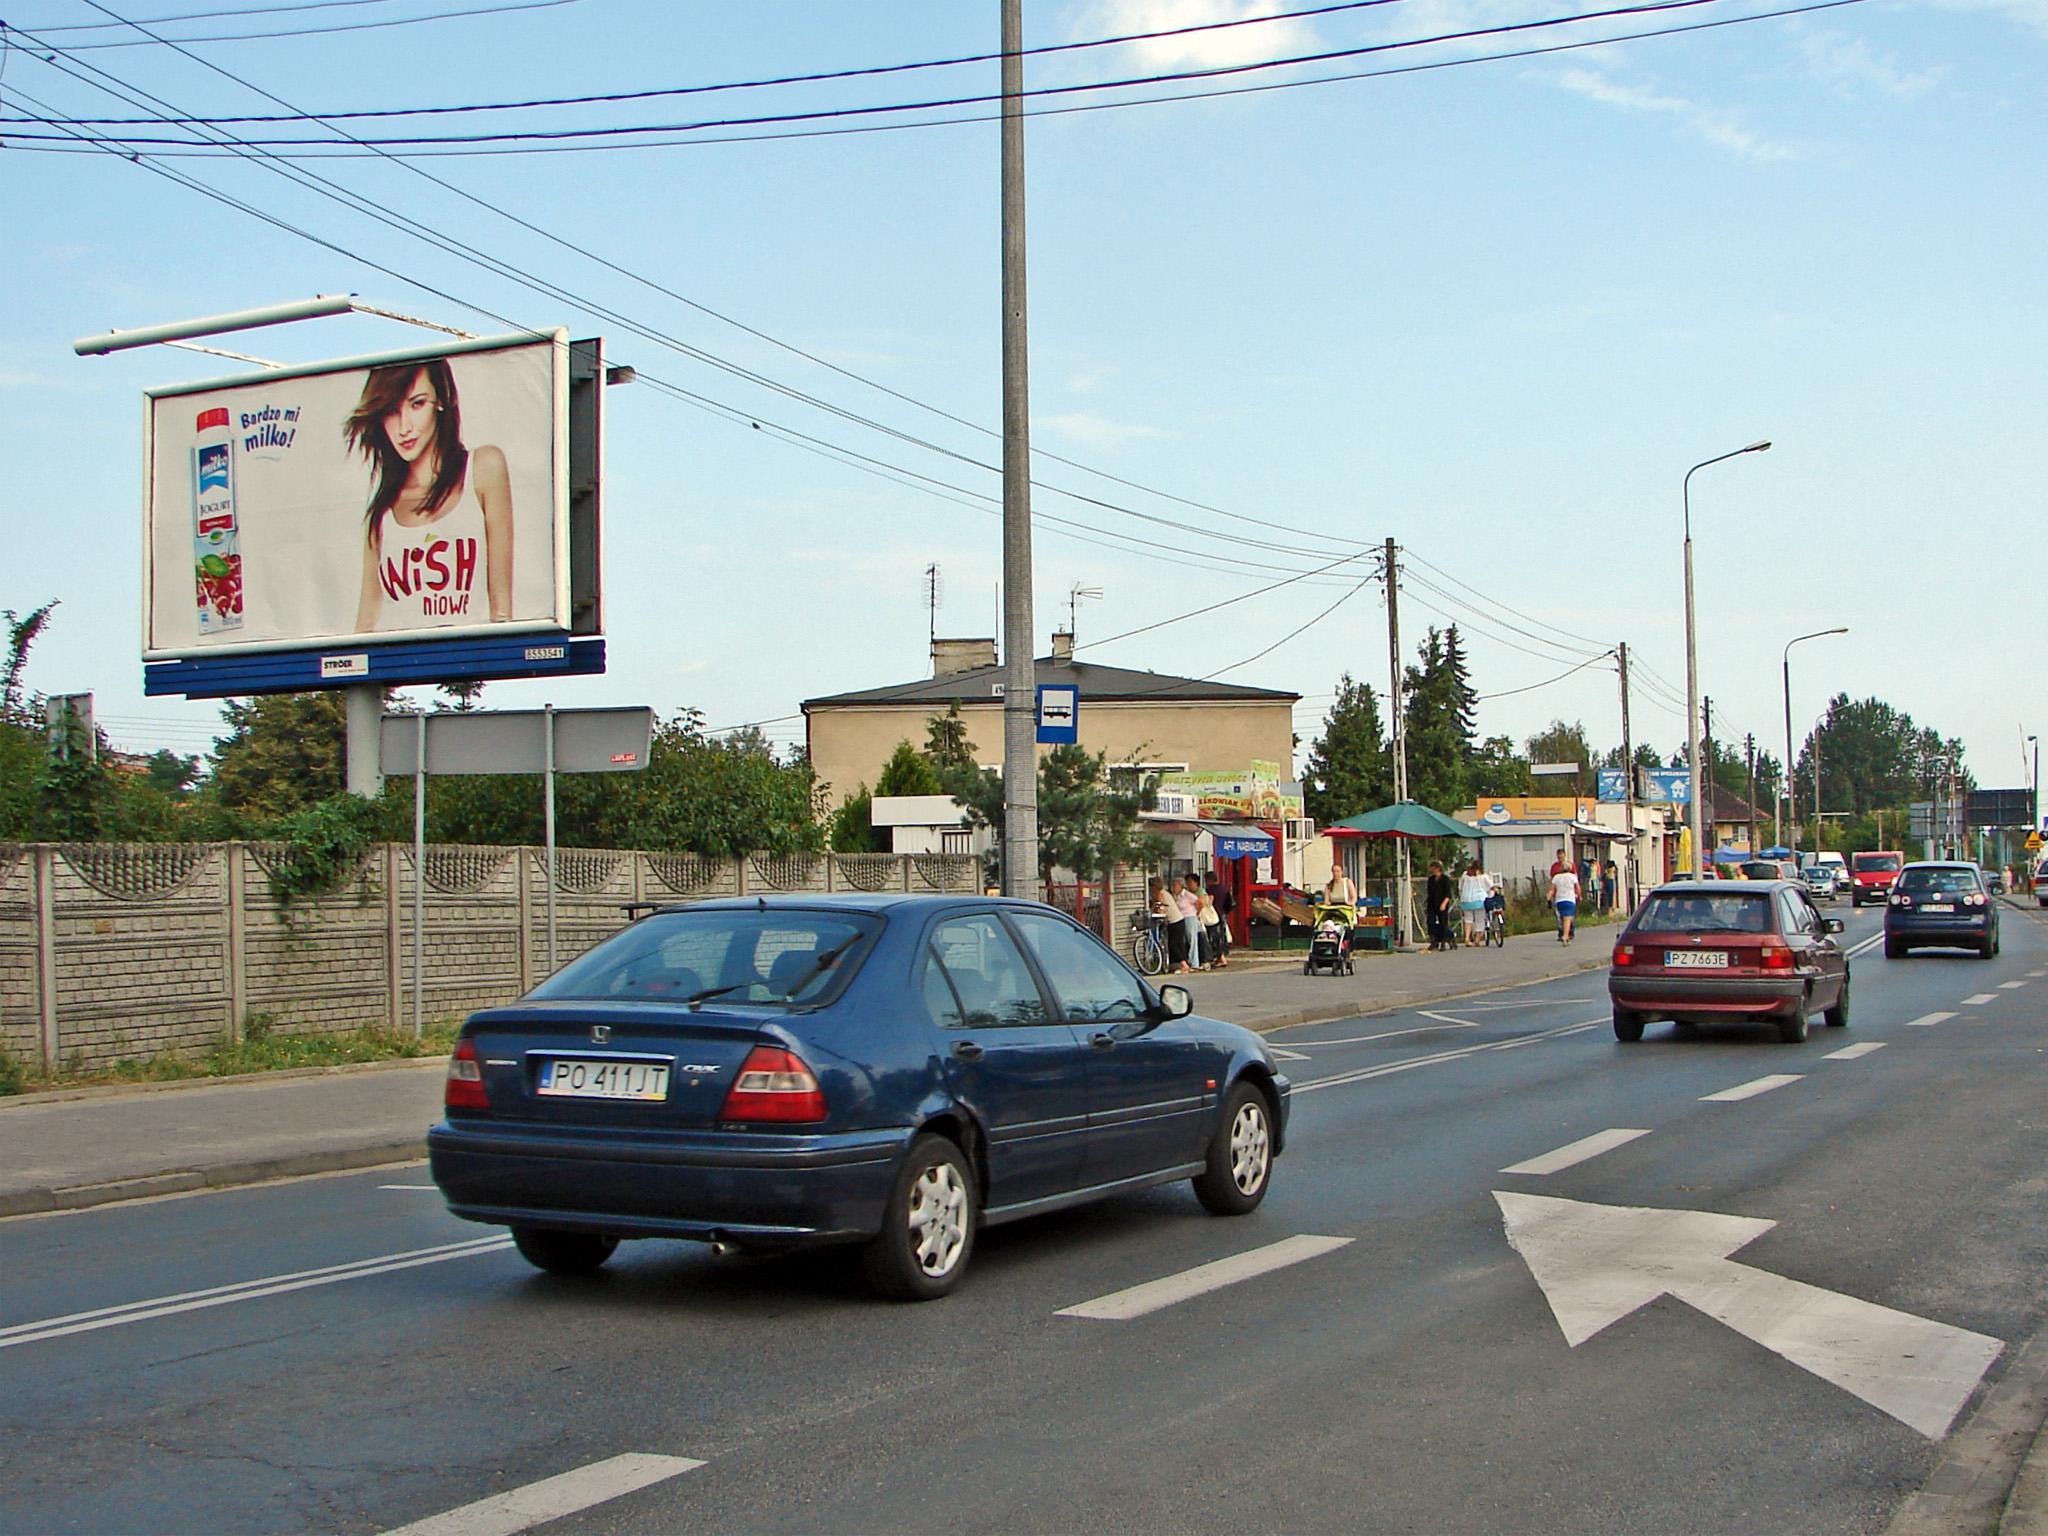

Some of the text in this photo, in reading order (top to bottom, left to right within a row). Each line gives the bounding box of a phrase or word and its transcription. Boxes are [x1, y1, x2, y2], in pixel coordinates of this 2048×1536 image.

[240, 404, 302, 429] Bardzo mi
[244, 423, 296, 452] milko!
[199, 500, 231, 516] JOGURT
[423, 593, 469, 616] niowe
[1672, 953, 1726, 965] PZ 7663E
[554, 1063, 666, 1094] PO 411JT
